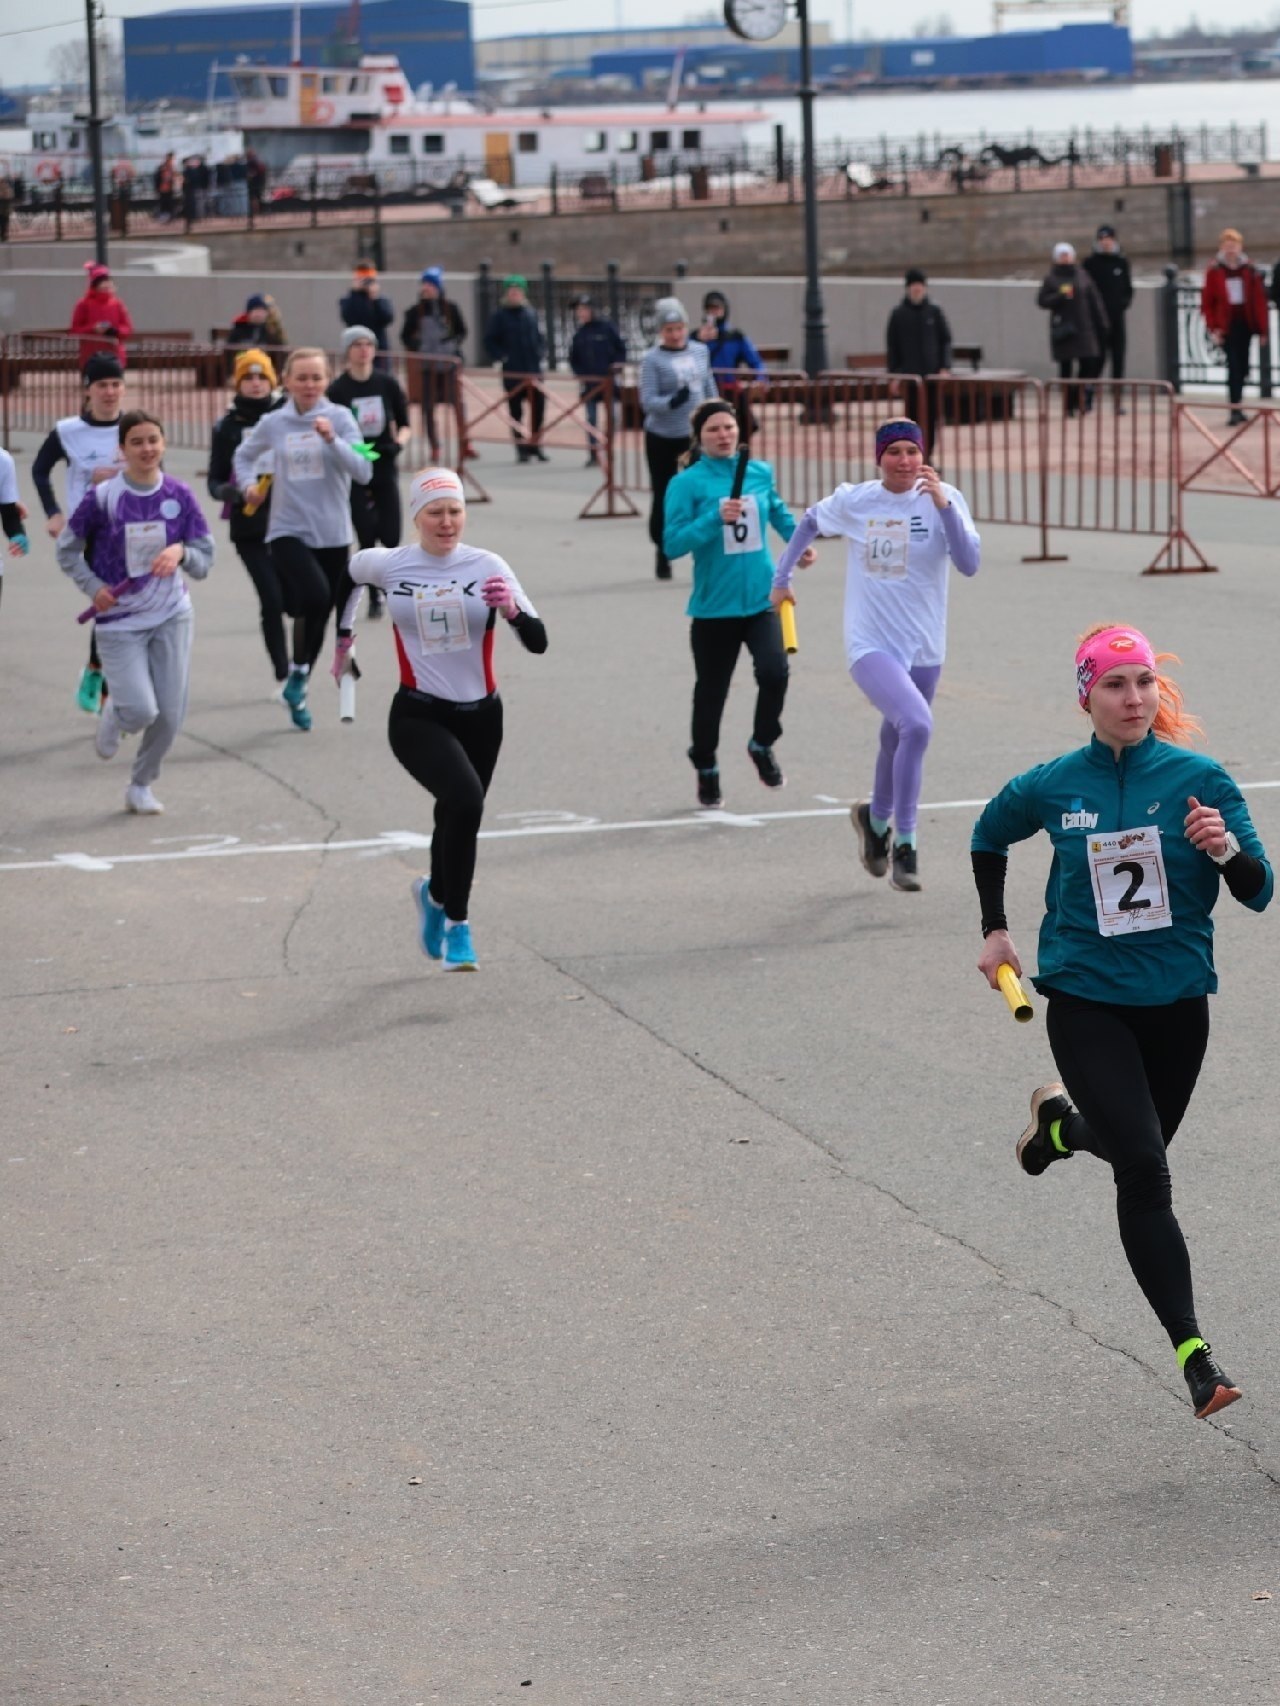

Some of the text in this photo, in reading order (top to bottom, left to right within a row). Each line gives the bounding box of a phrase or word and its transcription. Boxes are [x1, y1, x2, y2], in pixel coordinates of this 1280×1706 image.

[871, 537, 892, 559] 10
[393, 581, 477, 597] SX
[430, 607, 449, 634] 4
[1113, 862, 1152, 911] 2
